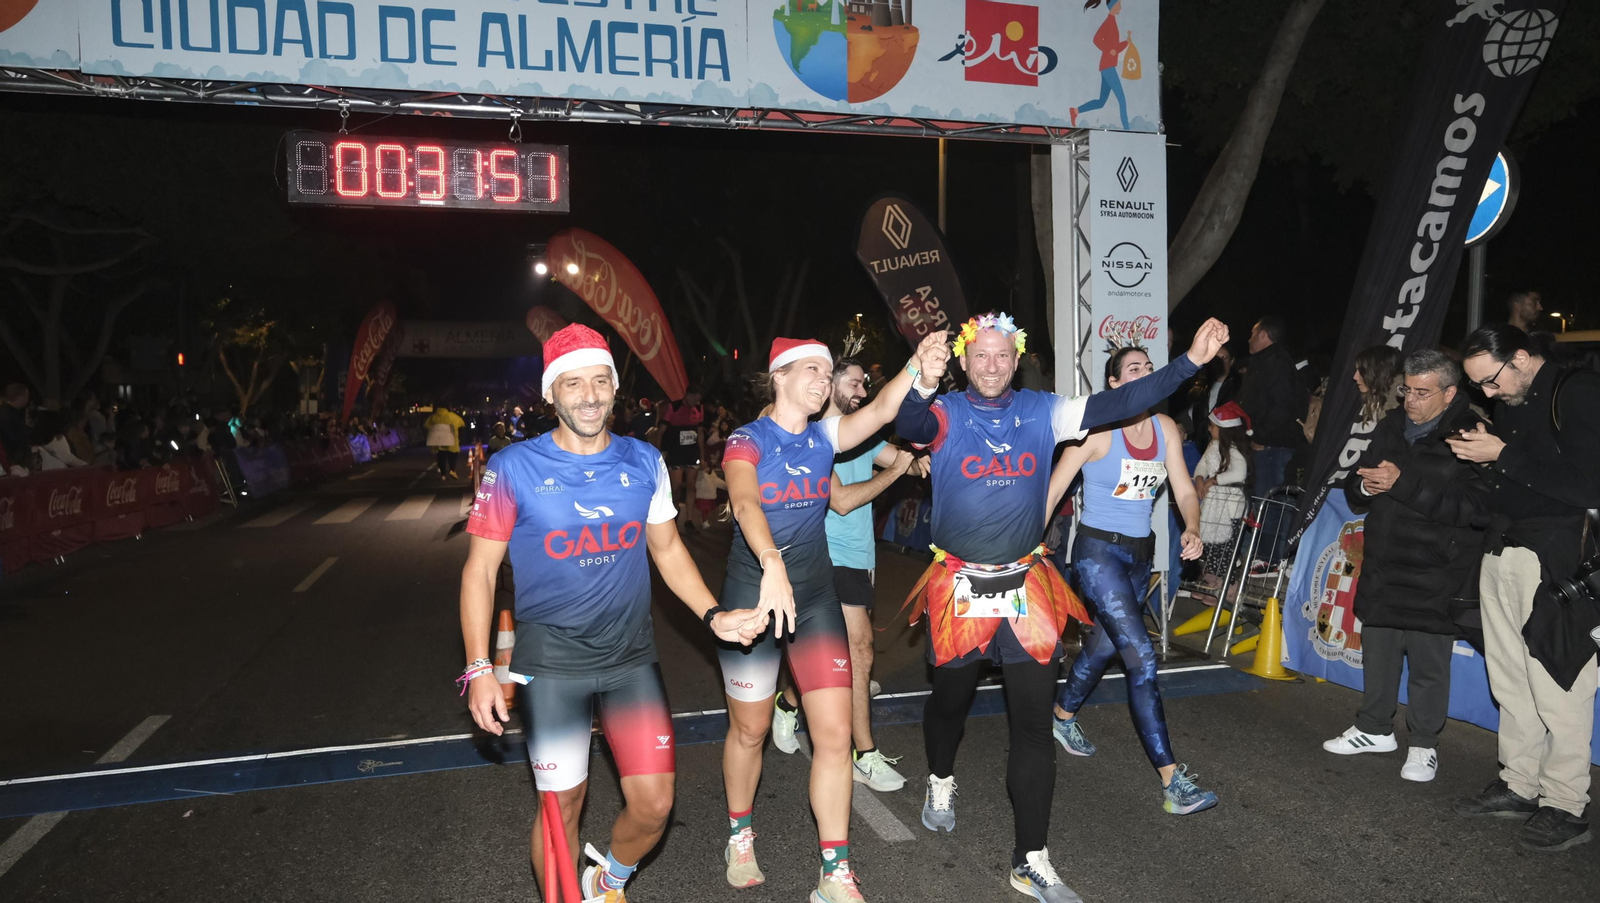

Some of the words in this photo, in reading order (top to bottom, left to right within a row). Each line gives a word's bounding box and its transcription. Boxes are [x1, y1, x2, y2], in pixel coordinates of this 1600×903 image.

[111, 0, 358, 60] CIUDAD
[378, 5, 458, 66] DE
[478, 12, 731, 82] ALMERÍA
[1100, 199, 1155, 211] RENAULT
[1100, 210, 1118, 218] SYRSA
[1383, 92, 1486, 345] tacamos
[1102, 260, 1153, 270] NISSAN
[1107, 290, 1152, 298] andalmotor.es
[961, 452, 1037, 480] GALO
[986, 479, 1017, 487] SPORT
[1132, 474, 1158, 488] 112
[534, 485, 565, 494] SPIRAL
[760, 476, 831, 505] GALO
[784, 501, 814, 510] SPORT
[543, 520, 642, 560] GALO
[579, 554, 616, 568] SPORT
[730, 678, 754, 690] GALO
